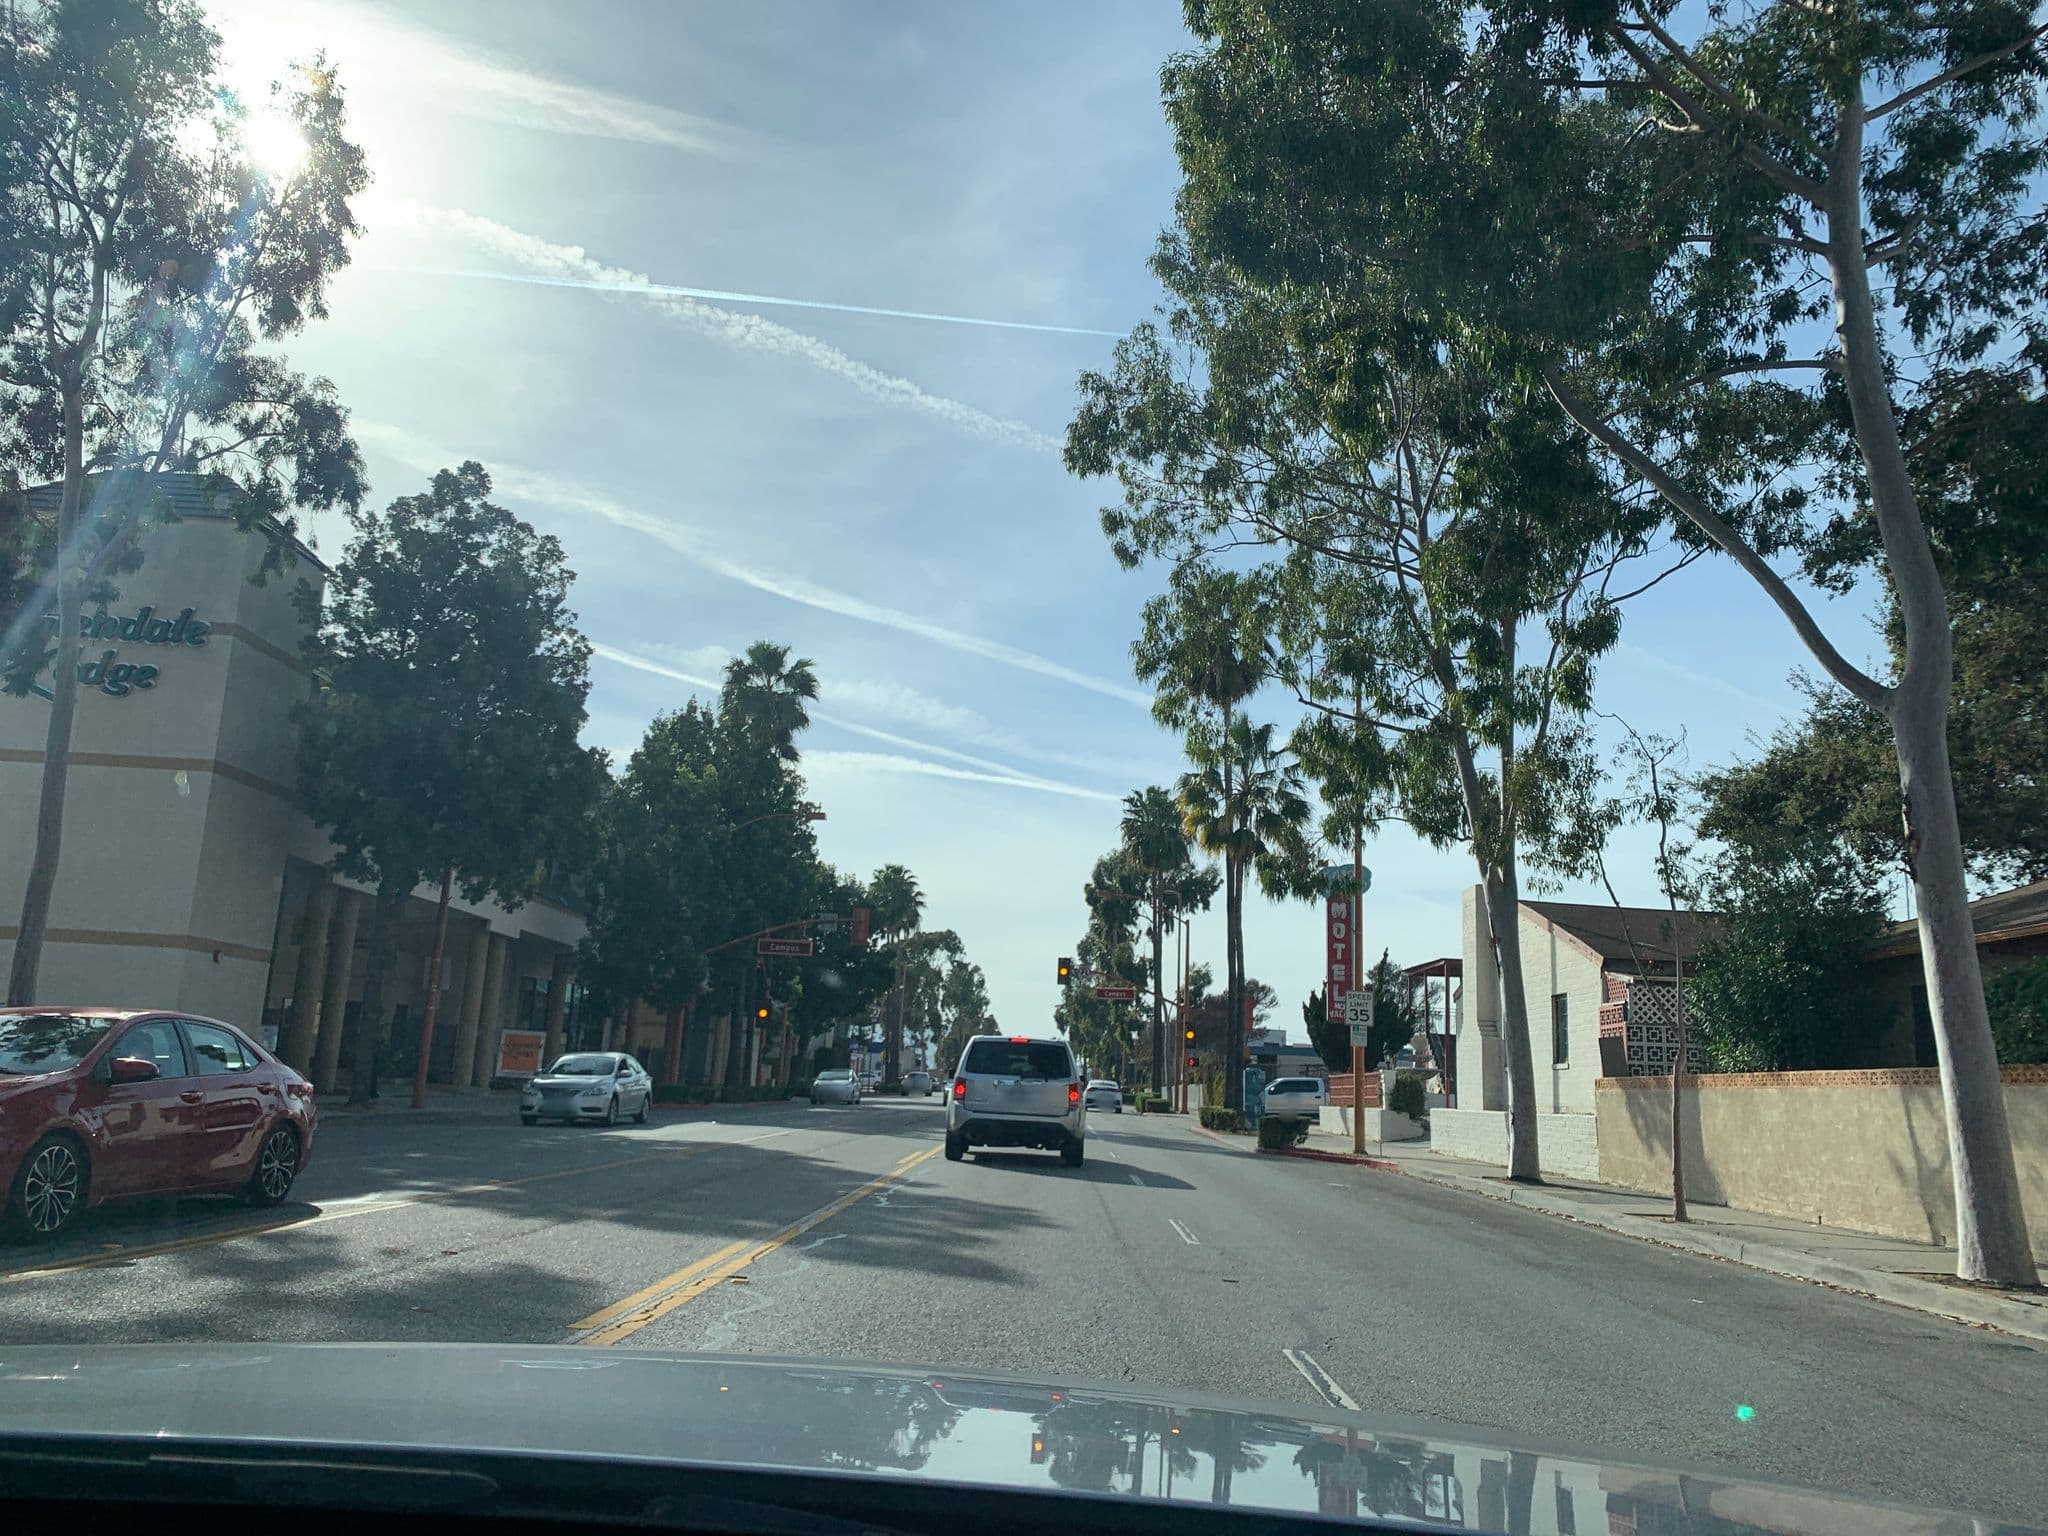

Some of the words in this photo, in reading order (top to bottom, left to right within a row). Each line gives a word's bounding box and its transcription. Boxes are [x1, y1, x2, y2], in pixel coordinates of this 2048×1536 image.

[769, 943, 800, 952] Campus
[1331, 902, 1347, 1001] MOTEL
[1347, 993, 1371, 1001] SPEED
[1349, 1008, 1370, 1022] 35
